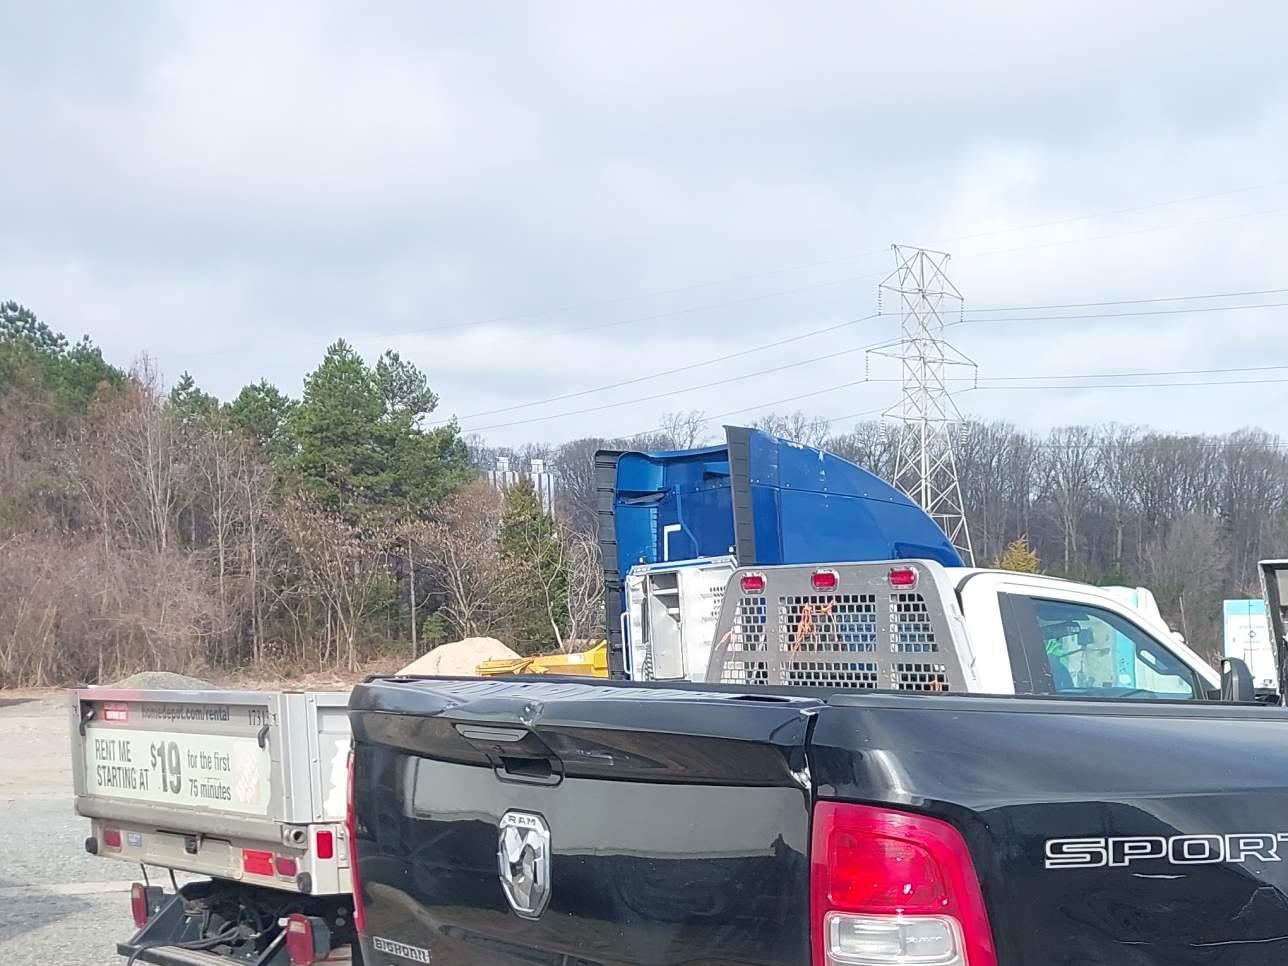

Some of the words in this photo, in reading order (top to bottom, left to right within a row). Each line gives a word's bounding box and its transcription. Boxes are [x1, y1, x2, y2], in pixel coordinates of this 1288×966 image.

[95, 738, 117, 762] RENT
[118, 740, 132, 763] ME
[187, 750, 198, 769] for
[199, 752, 213, 770] the
[213, 752, 231, 772] first
[97, 765, 137, 789] STARTING
[139, 768, 149, 791] AT
[150, 741, 182, 795] $19
[188, 778, 199, 797] 75
[200, 779, 232, 801] minutes
[508, 815, 537, 826] RAM
